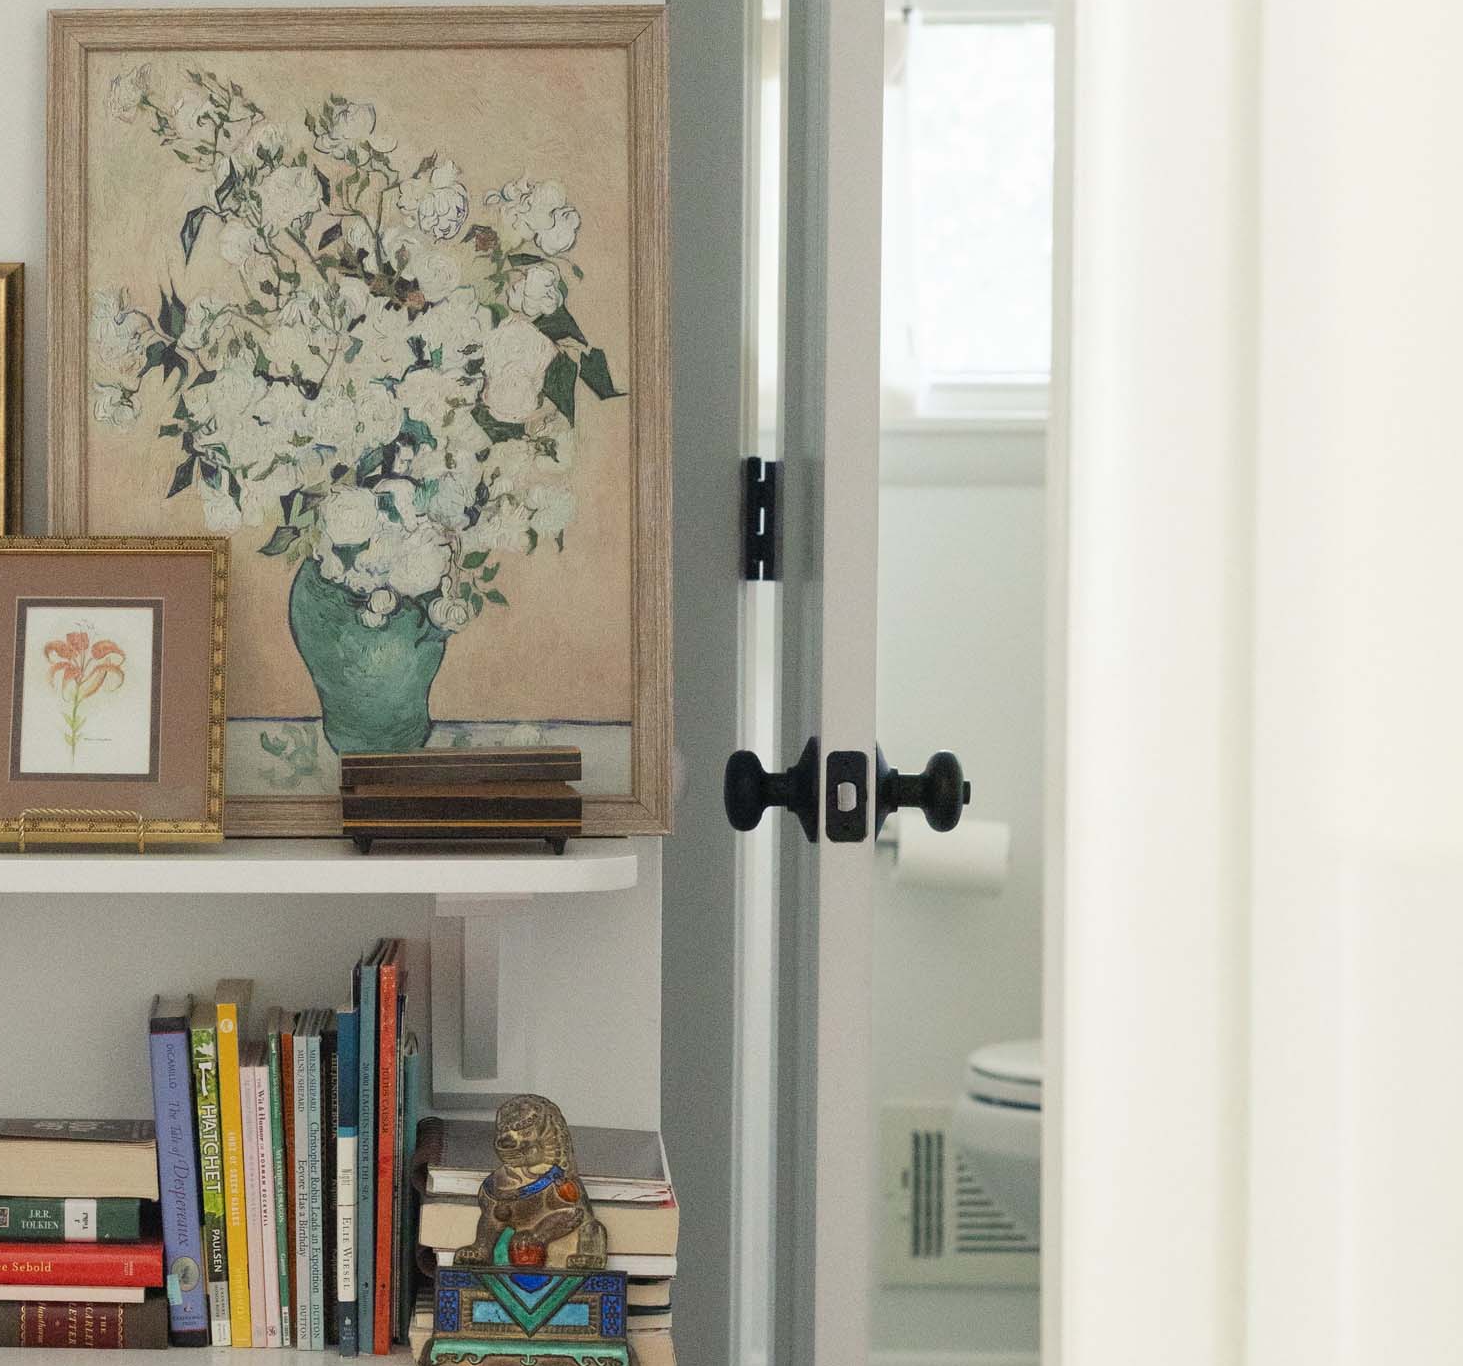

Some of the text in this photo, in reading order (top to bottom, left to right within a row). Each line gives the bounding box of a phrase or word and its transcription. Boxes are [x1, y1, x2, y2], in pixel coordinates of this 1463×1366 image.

[257, 1090, 265, 1104] Wit
[202, 1105, 221, 1192] HATCHET
[21, 1220, 59, 1230] TOLKIEN
[30, 1209, 52, 1219] J.R.R.
[169, 1161, 189, 1249] Despereaux
[297, 1160, 308, 1257] Eeyore Has Birthday
[309, 1122, 322, 1294] Christopher Robin Leads Expotition
[12, 1261, 52, 1273] Sebold
[212, 1228, 222, 1272] PAULSEN
[343, 1247, 353, 1291] WIESEL
